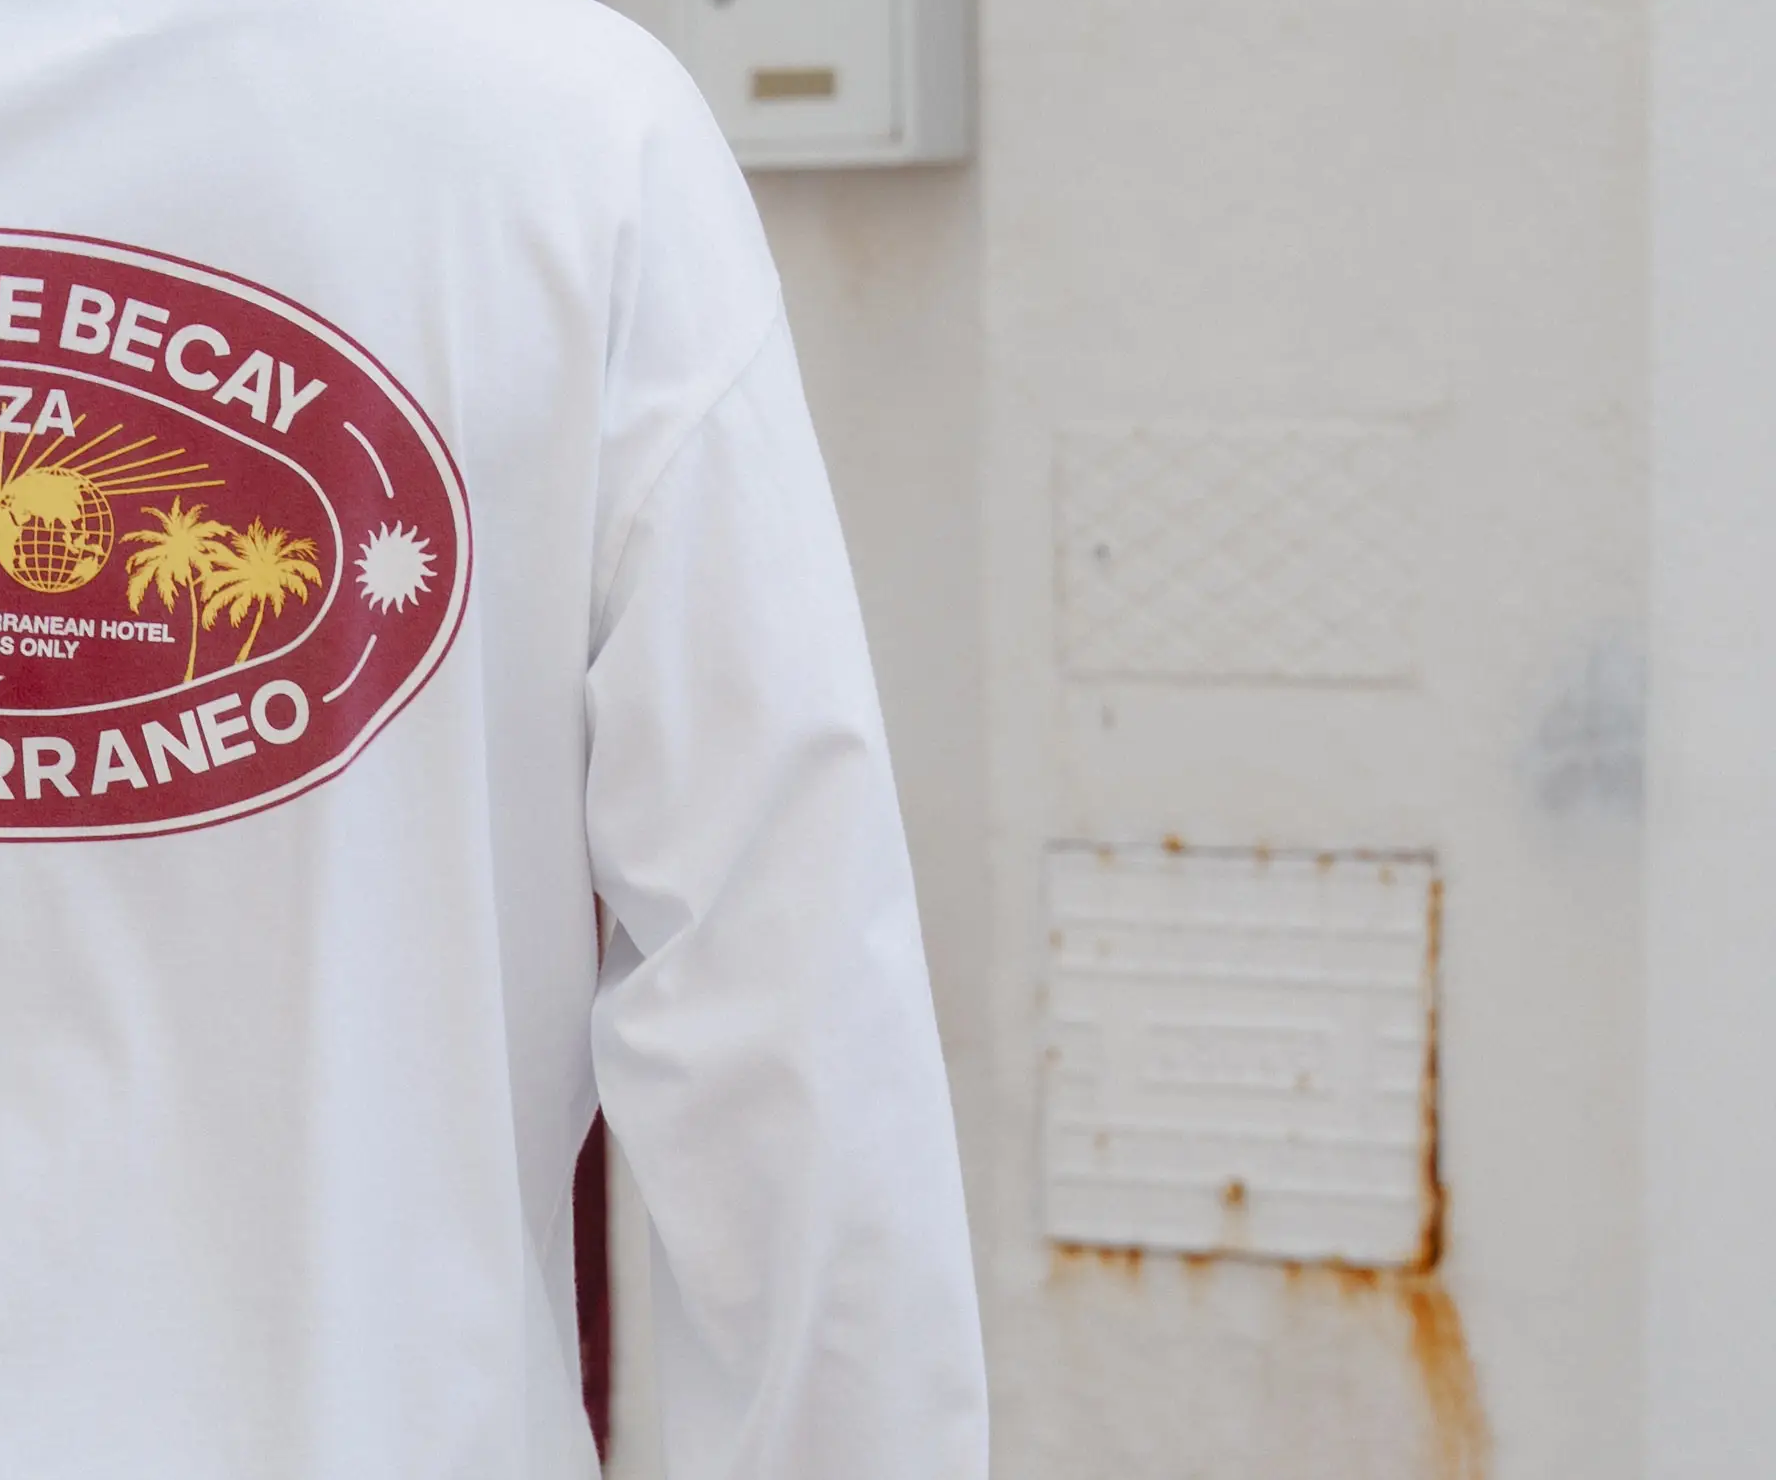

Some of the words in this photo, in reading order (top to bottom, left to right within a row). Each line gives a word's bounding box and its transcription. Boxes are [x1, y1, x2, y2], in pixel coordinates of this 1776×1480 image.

[60, 283, 328, 434] BECAY
[100, 619, 176, 643] HOTEL
[19, 637, 80, 659] ONLY
